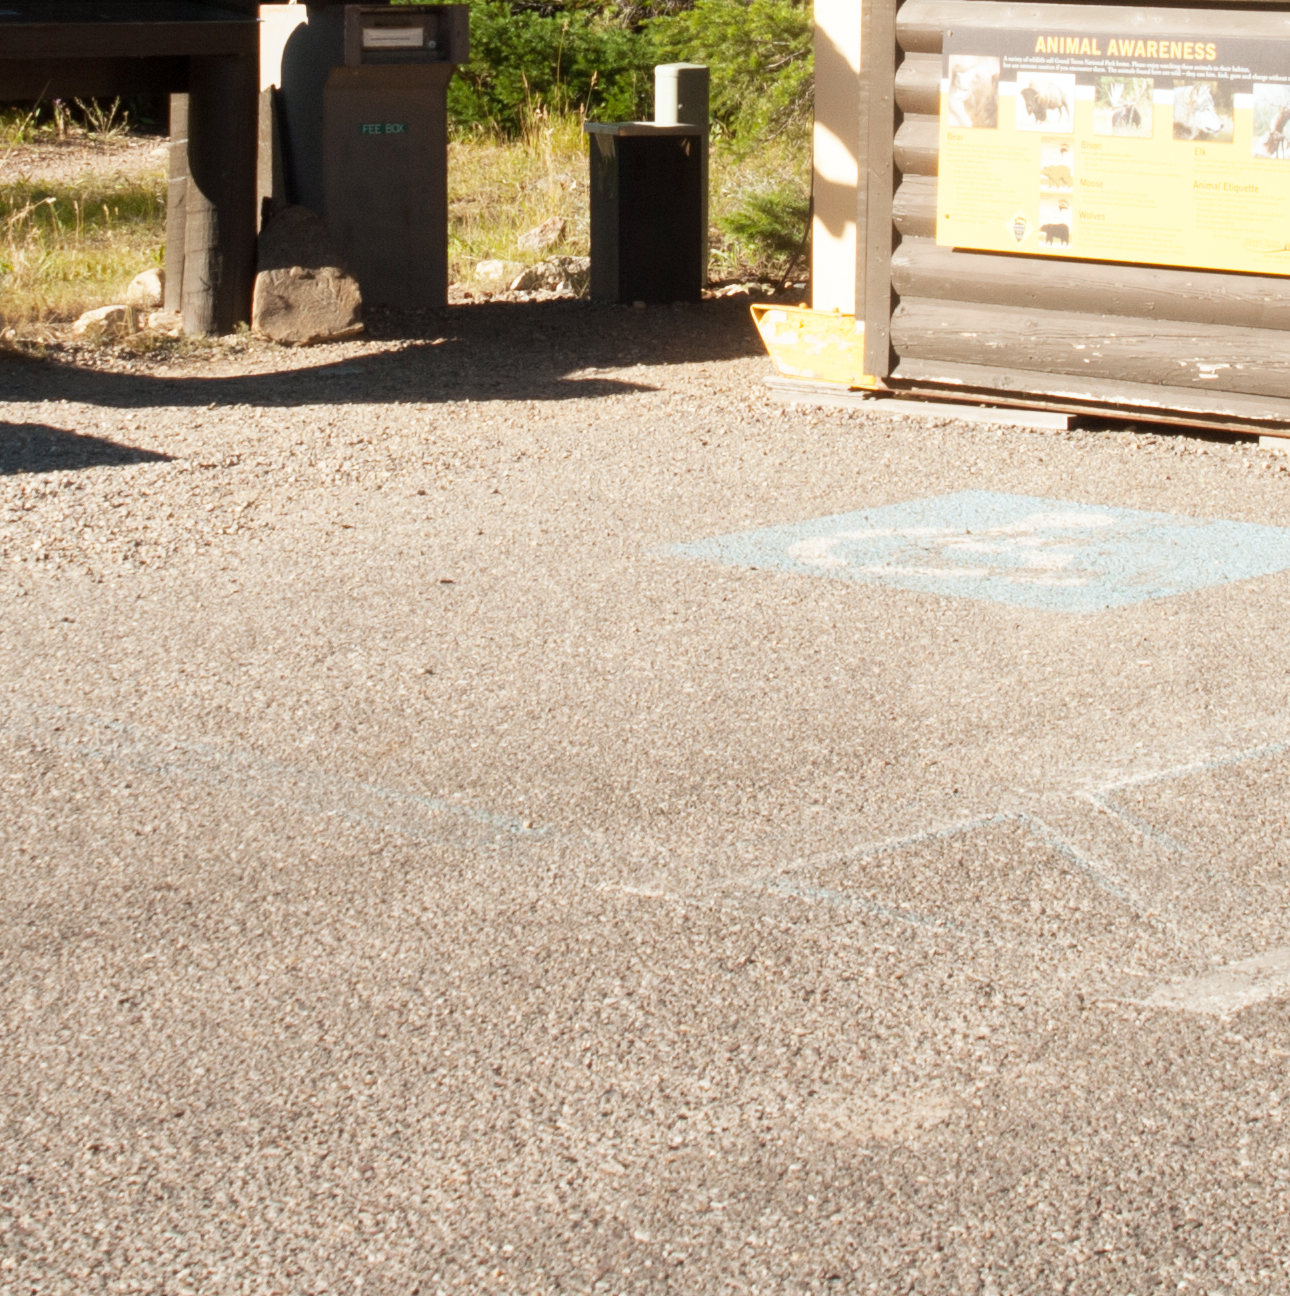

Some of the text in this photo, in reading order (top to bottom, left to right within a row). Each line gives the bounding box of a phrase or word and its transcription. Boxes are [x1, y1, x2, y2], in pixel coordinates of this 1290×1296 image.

[1034, 36, 1217, 61] ANIMAL AWARENESS
[362, 123, 404, 135] FEE BOX
[947, 132, 963, 141] Bear
[1080, 141, 1102, 150] Bison
[1194, 147, 1207, 156] Elk
[1079, 179, 1104, 189] Moose
[1193, 180, 1259, 193] Animal Etiquette
[1078, 211, 1105, 221] Wolves
